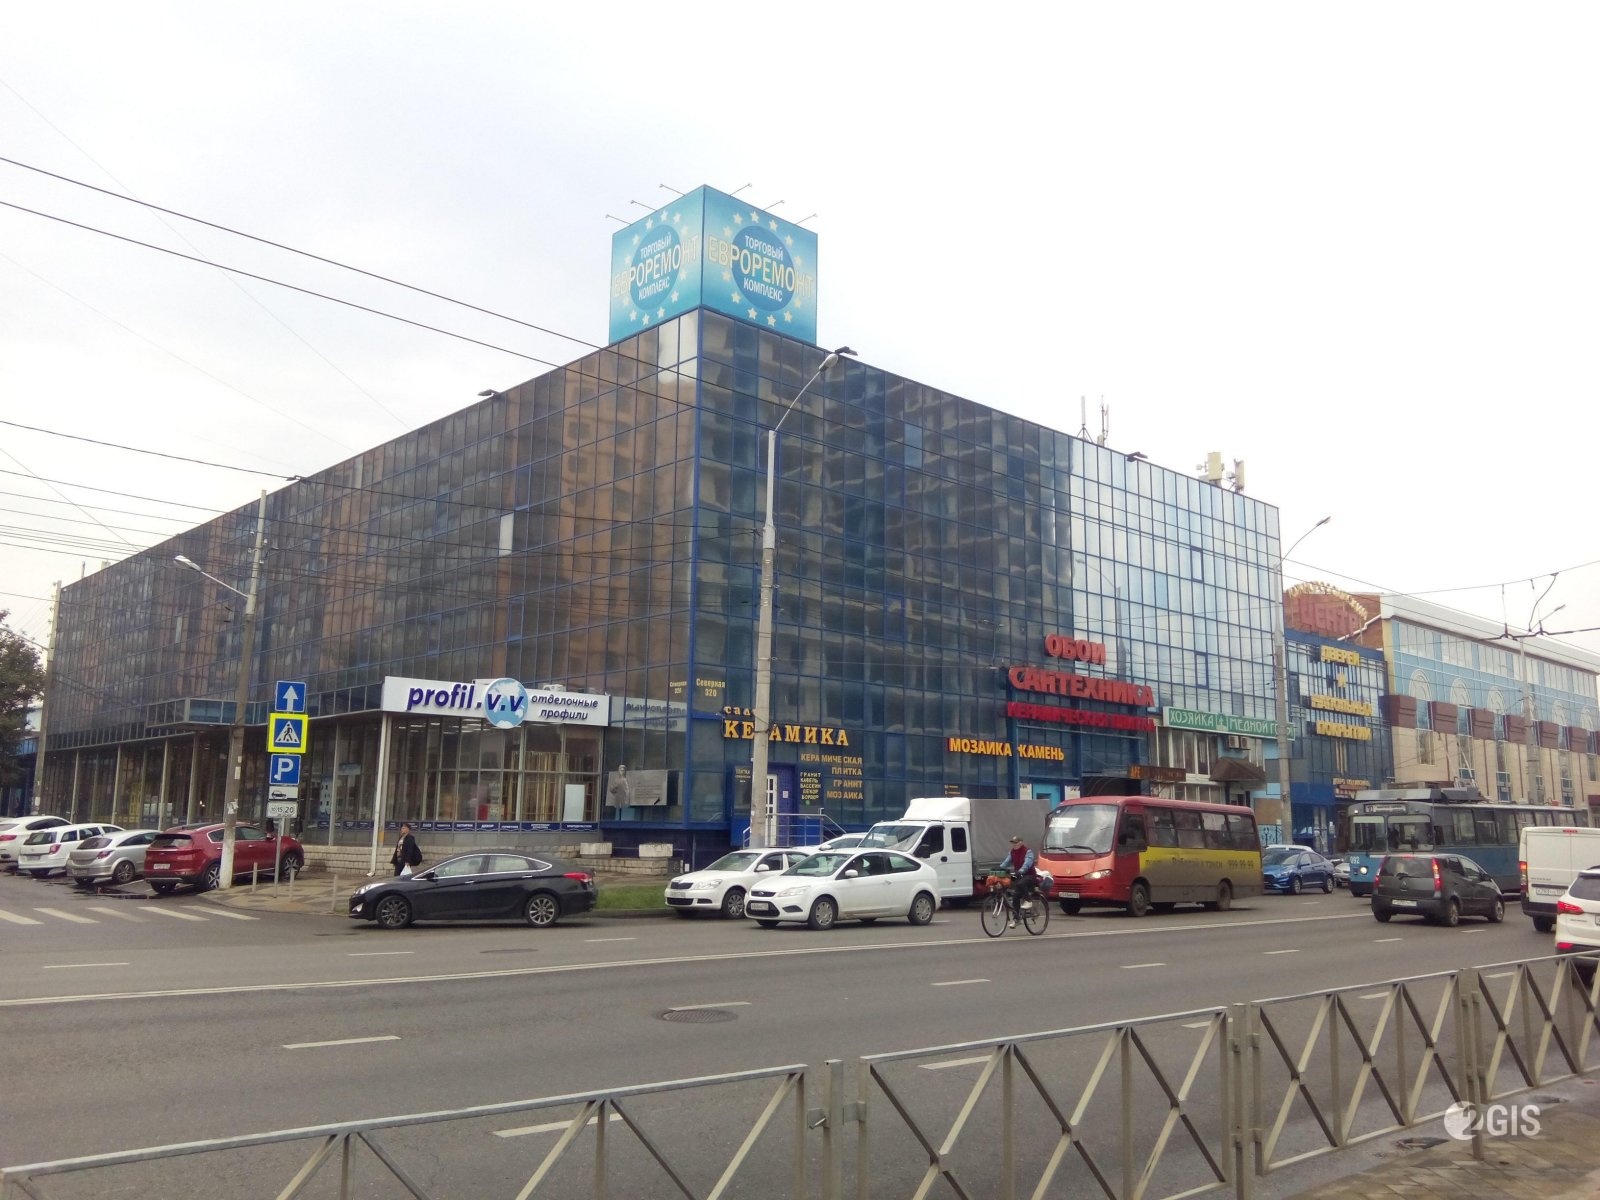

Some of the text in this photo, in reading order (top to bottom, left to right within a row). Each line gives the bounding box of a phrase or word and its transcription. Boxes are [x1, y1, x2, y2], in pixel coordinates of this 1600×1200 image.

[640, 233, 672, 259] ТОРГОВЫЙ
[744, 235, 783, 260] ТОРГОВЫЙ
[614, 234, 699, 298] ЕВРОРЕМОНТ
[708, 234, 814, 299] ЕВРОРЕМОНТ
[638, 276, 671, 301] КОМПЛЕКС
[743, 276, 783, 302] КОМПЛЕКС
[1045, 633, 1105, 665] ОБОИ
[696, 678, 726, 689] Северная
[704, 688, 717, 697] 320
[1008, 665, 1155, 708] САНТЕХНИКА
[531, 693, 599, 709] отделочные
[540, 708, 588, 721] профили
[1170, 710, 1214, 727] ХОЗЯЙКА
[1229, 718, 1268, 735] МЕДНОЙ
[723, 720, 849, 746] КЕАМИКА
[949, 737, 1065, 761] МОЗАИКА КАМЕНЬ
[831, 766, 863, 776] ПЛИТКА
[833, 779, 863, 788] ГРАНИТ
[826, 790, 863, 800] МОЗАИКА
